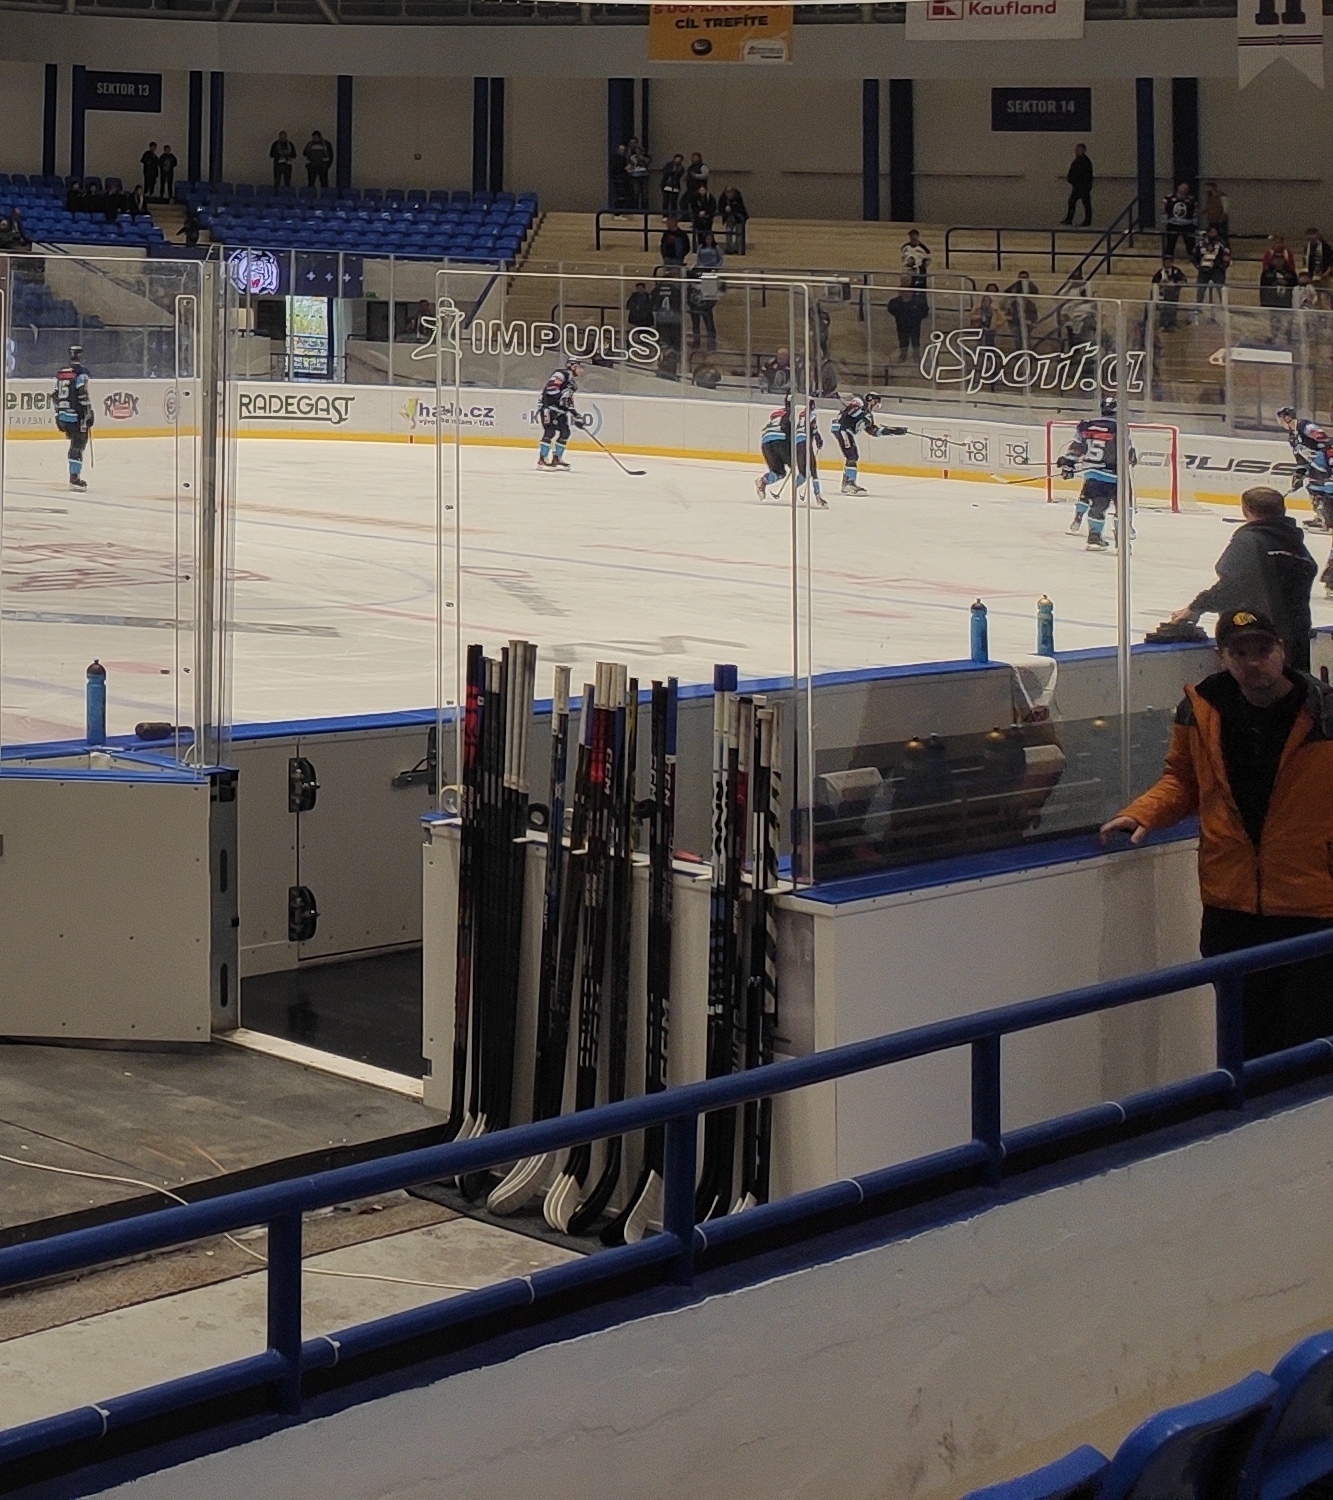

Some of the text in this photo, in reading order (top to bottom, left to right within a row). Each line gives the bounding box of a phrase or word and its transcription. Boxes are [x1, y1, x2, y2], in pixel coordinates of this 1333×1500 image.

[969, 0, 1057, 16] Kaufland
[675, 14, 769, 29] CÍL TREFÍTE
[96, 82, 150, 96] SEKTOR 13
[1006, 100, 1075, 113] SEKTOR 14
[472, 320, 661, 363] IMPULS
[239, 394, 356, 424] RADEGAST
[604, 747, 614, 796] CCM
